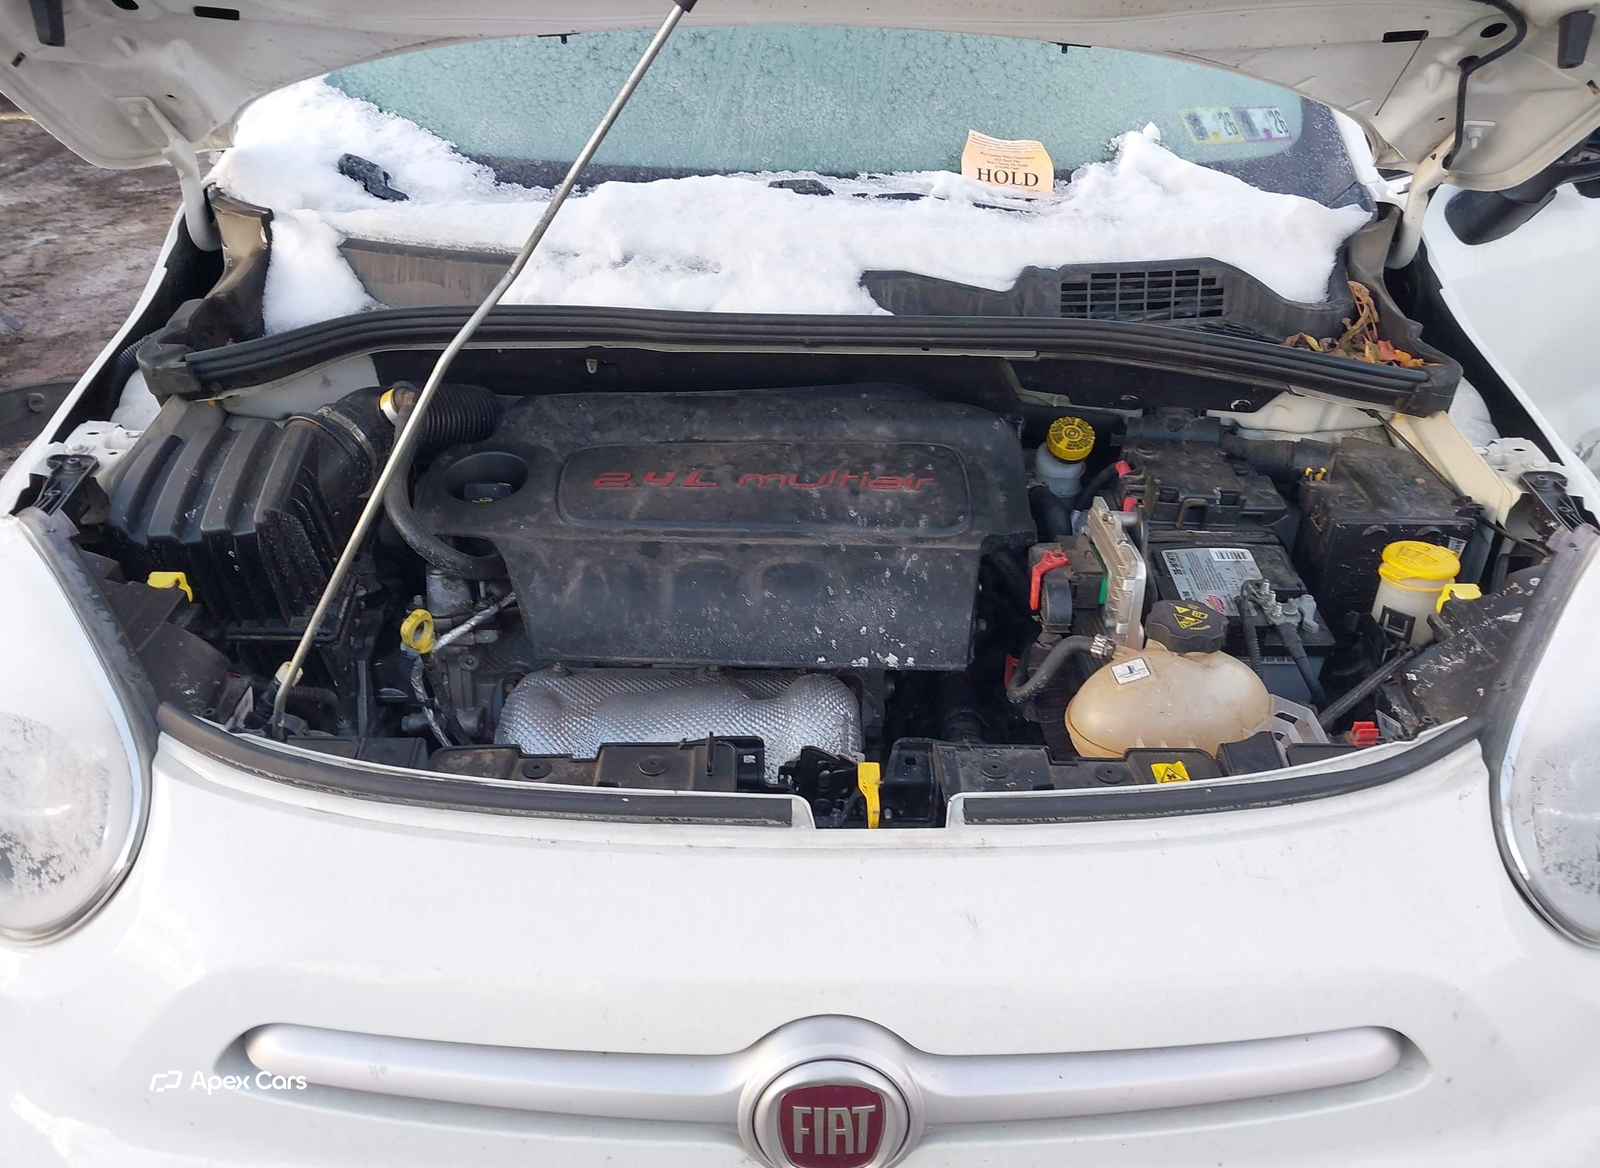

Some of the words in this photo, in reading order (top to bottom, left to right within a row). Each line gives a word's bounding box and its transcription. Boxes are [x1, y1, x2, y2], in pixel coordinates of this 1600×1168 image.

[1267, 109, 1289, 134] 26
[976, 167, 1039, 187] HOLD
[593, 471, 719, 488] 2.4L
[737, 469, 935, 491] multiair
[792, 1104, 877, 1155] FIAT
